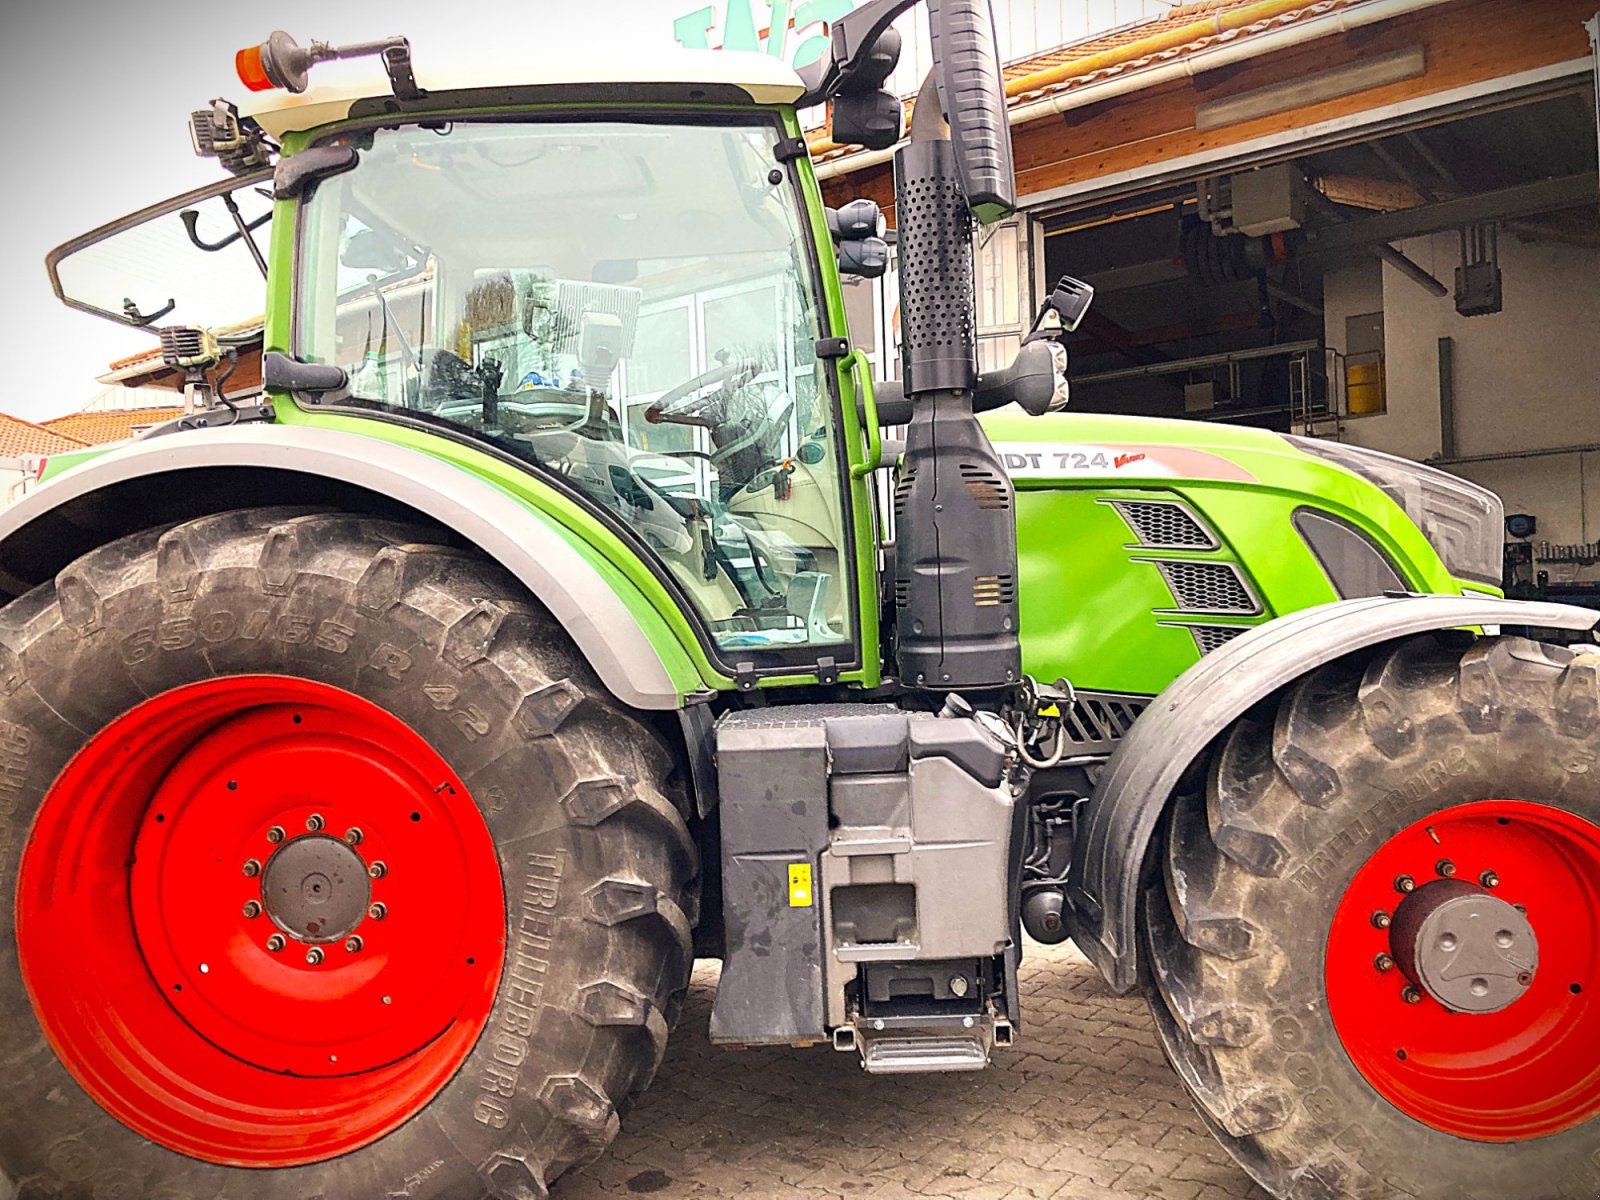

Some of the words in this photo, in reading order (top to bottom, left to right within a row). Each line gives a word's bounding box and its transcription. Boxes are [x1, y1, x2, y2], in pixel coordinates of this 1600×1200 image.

[1052, 453, 1109, 469] 724
[121, 609, 357, 666] 650/65
[367, 642, 413, 680] R
[423, 684, 491, 744] 42
[1289, 745, 1470, 893] TRELLEBORG
[473, 848, 568, 1130] TRELLEBORG
